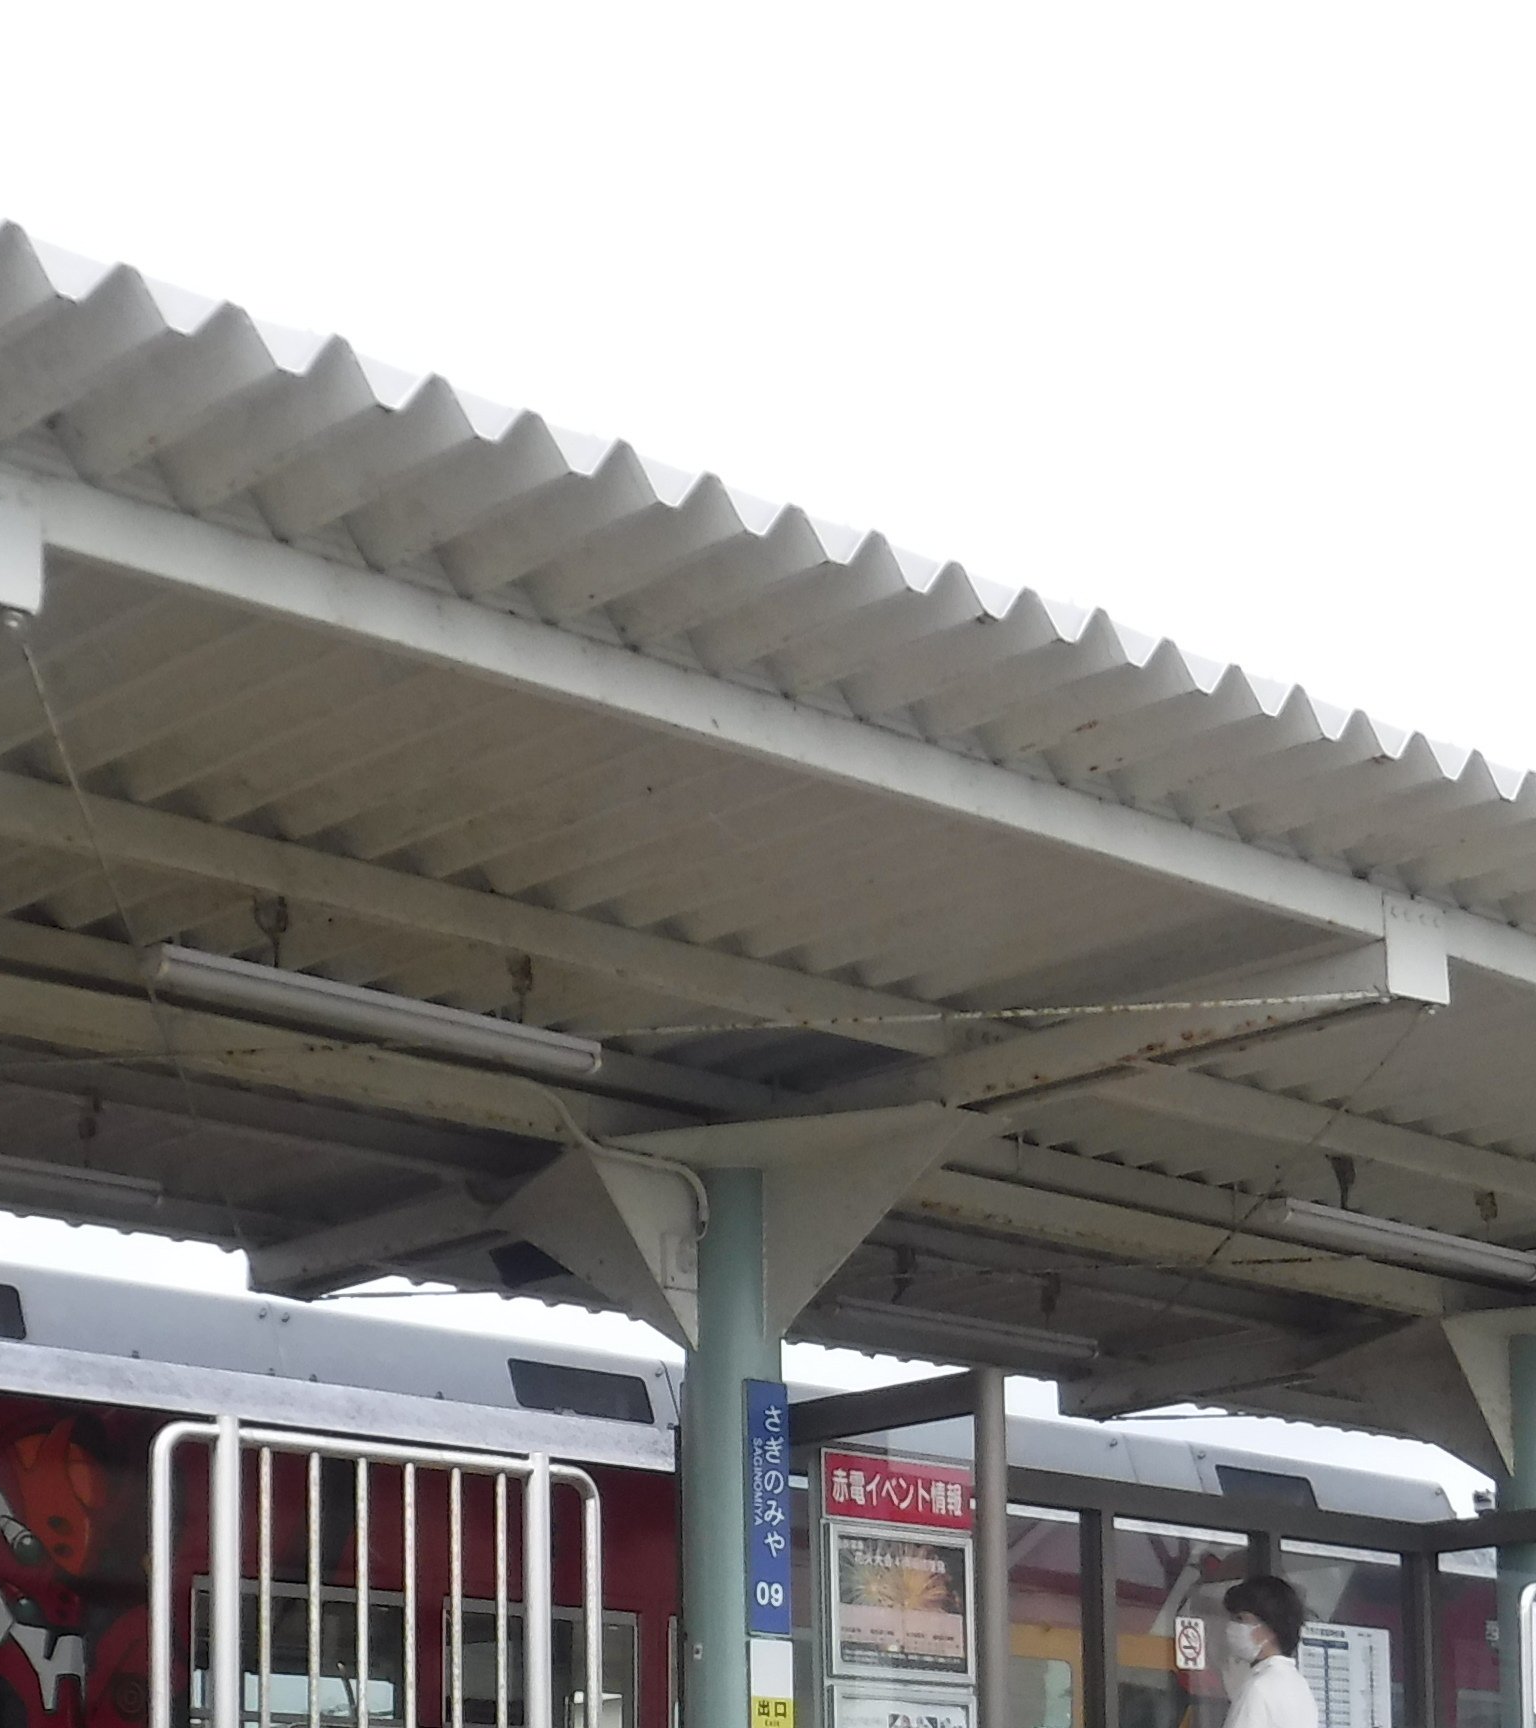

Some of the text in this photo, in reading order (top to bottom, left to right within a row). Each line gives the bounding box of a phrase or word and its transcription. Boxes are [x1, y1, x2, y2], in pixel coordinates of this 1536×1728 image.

[752, 1437, 764, 1527] SAGINOMIYA
[763, 1404, 786, 1558] さぎのみや
[831, 1467, 964, 1517] 赤電イベント情報
[755, 1580, 785, 1608] 09
[757, 1699, 787, 1718] 出口
